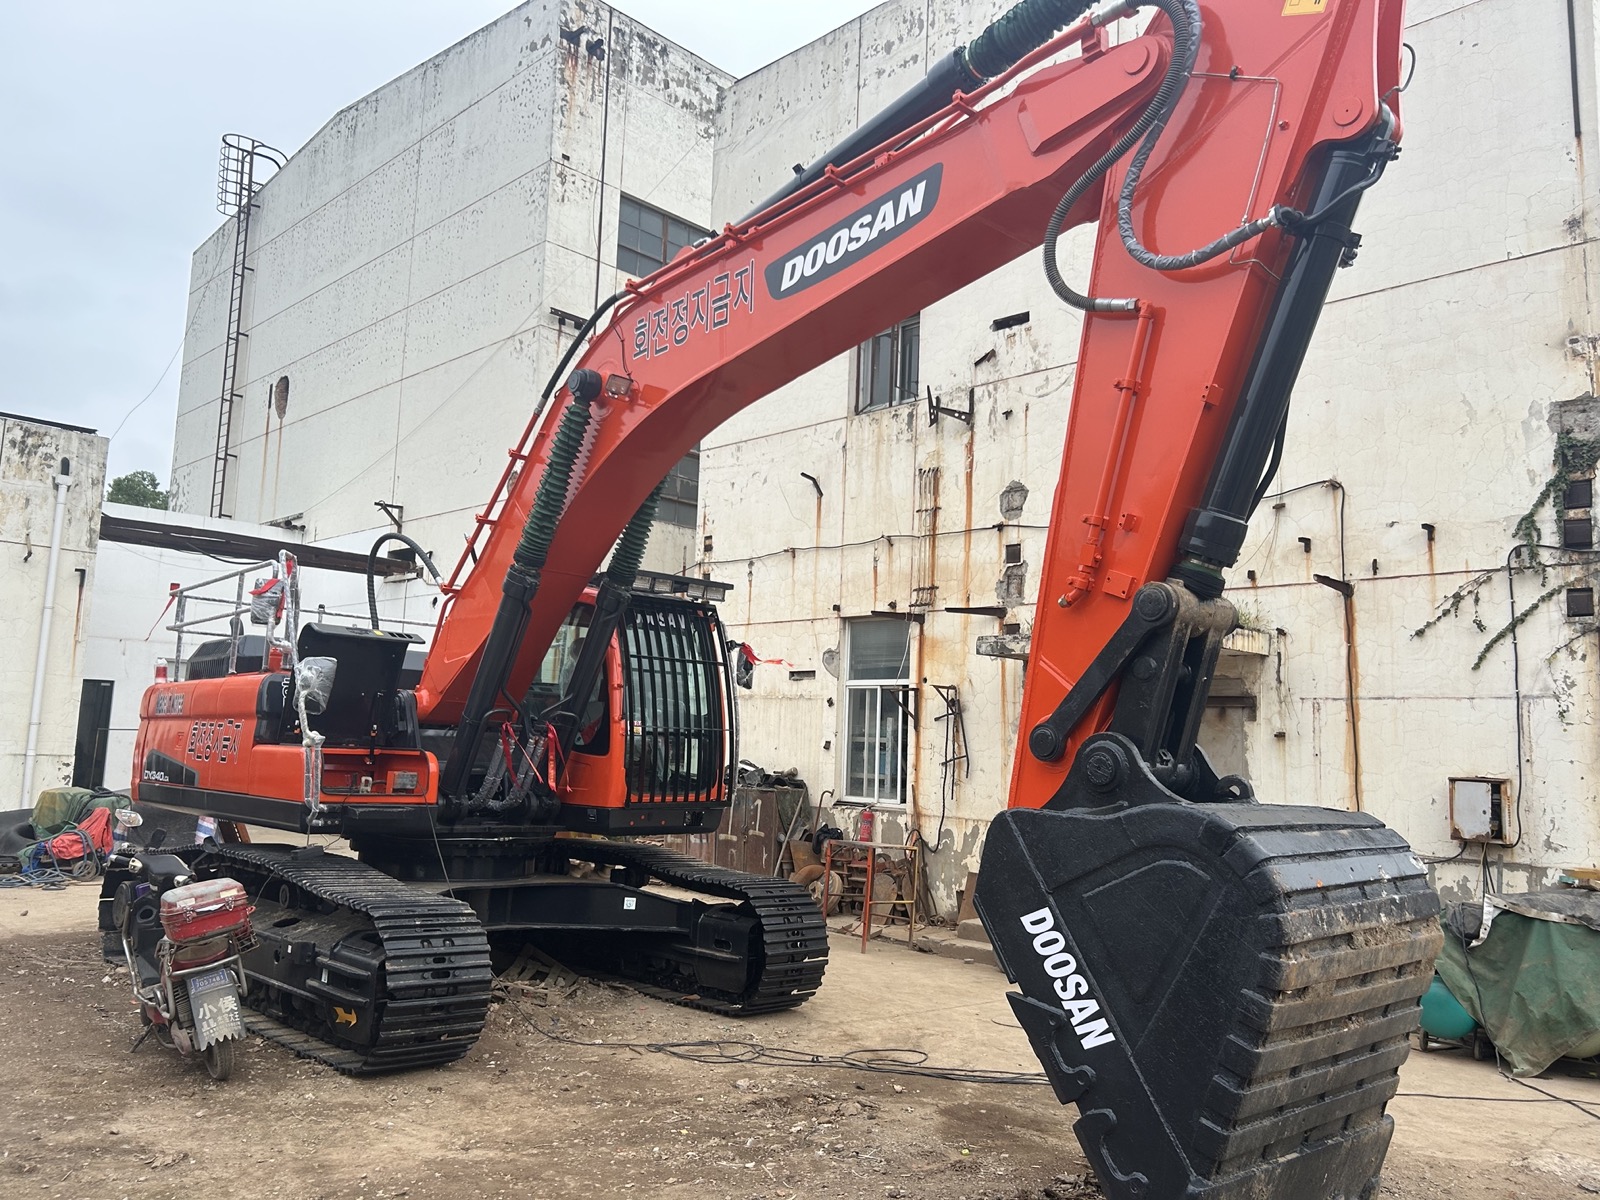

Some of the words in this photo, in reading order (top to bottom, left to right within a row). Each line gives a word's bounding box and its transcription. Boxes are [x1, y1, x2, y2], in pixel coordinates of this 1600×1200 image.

[780, 179, 927, 292] DOOSAN
[632, 258, 755, 360] 회전정지금지
[188, 718, 245, 765] 회전정지금지
[1019, 906, 1117, 1051] DOOSAN
